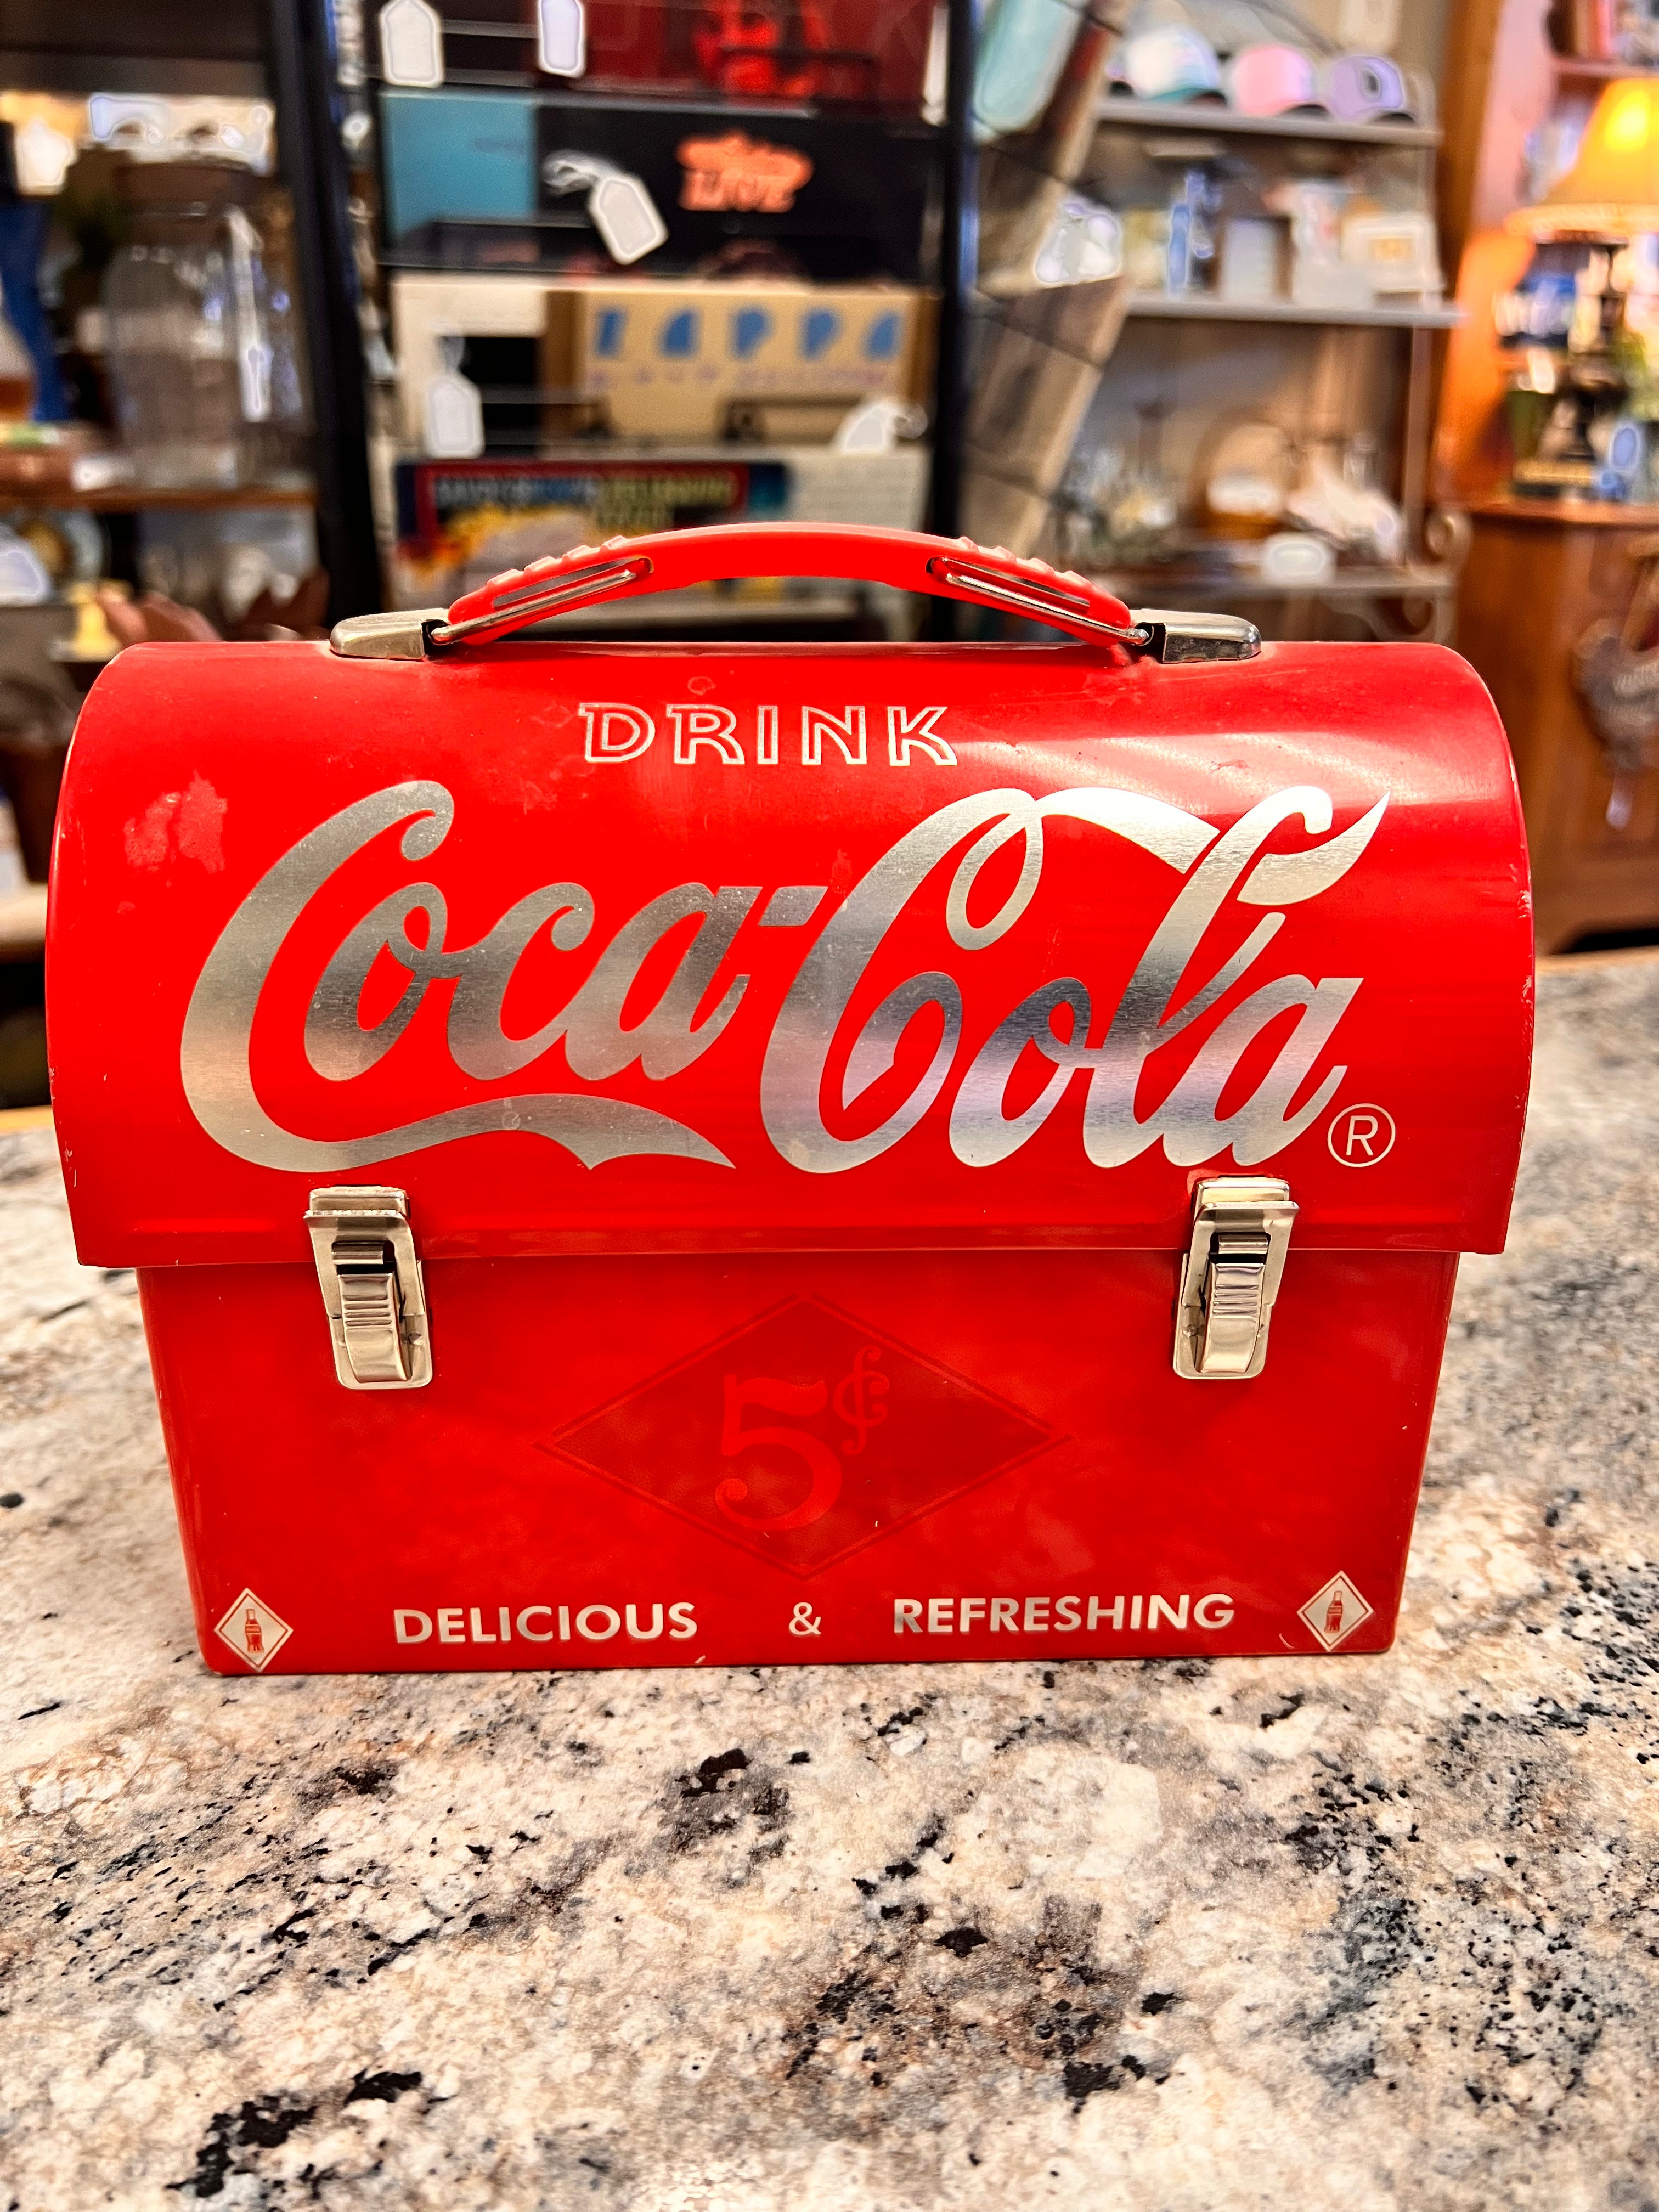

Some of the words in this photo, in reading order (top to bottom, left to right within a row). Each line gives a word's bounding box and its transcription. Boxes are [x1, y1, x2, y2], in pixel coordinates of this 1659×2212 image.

[579, 702, 958, 766] DRINK
[180, 780, 1390, 1173] Coca-Cola
[715, 1345, 890, 1531] 5¢
[393, 1601, 698, 1645] DELICIOUS
[788, 1601, 822, 1636] &
[893, 1593, 1234, 1634] REFRESHING
